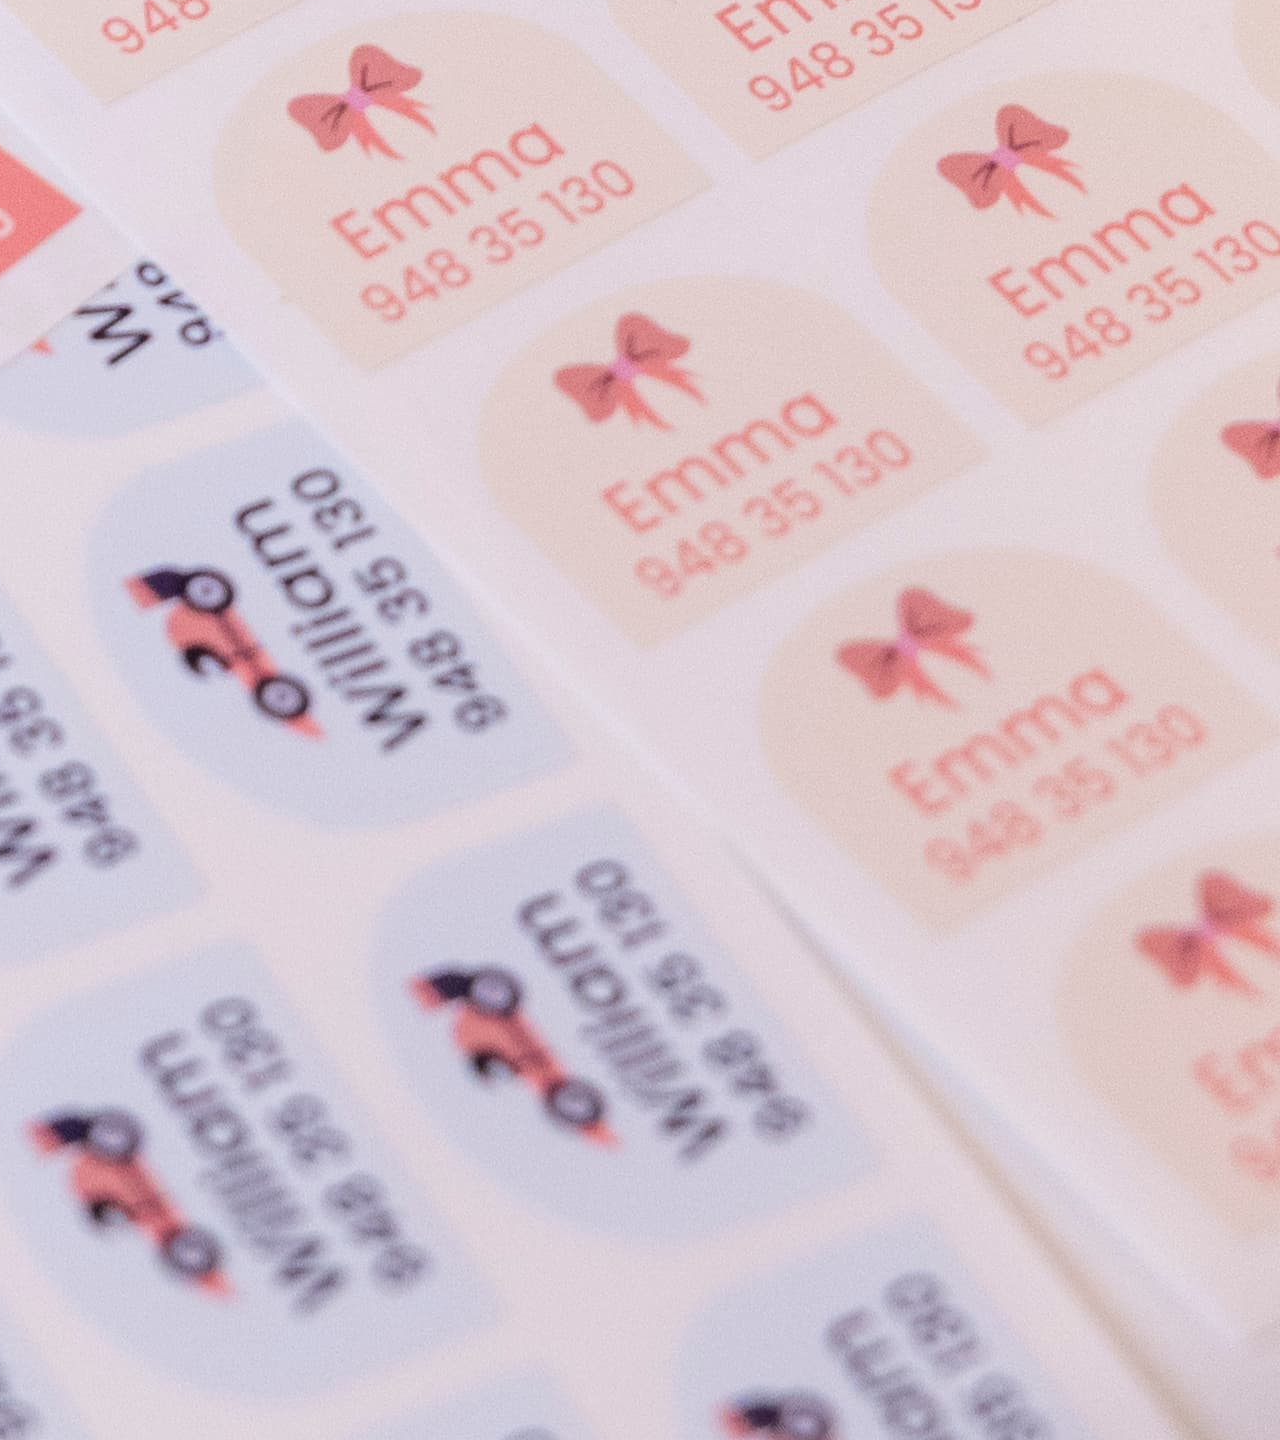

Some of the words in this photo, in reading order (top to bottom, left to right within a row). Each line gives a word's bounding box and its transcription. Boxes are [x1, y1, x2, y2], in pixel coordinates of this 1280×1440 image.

[746, 40, 856, 112] 948
[848, 1, 925, 58] 35
[328, 122, 565, 261] Emma
[359, 247, 473, 324] 948
[467, 206, 546, 265] 35
[537, 159, 636, 225] 130
[986, 182, 1215, 319] Emma
[1022, 306, 1133, 381] 948
[1124, 264, 1202, 323] 35
[1190, 218, 1280, 284] 130
[288, 467, 376, 552] 130
[598, 391, 840, 535] Emma
[632, 519, 750, 600] 948
[741, 476, 824, 539] 35
[811, 428, 914, 498] 130
[232, 497, 428, 752] William
[354, 555, 430, 623] 35
[406, 629, 507, 732] 948
[37, 761, 138, 866] 948
